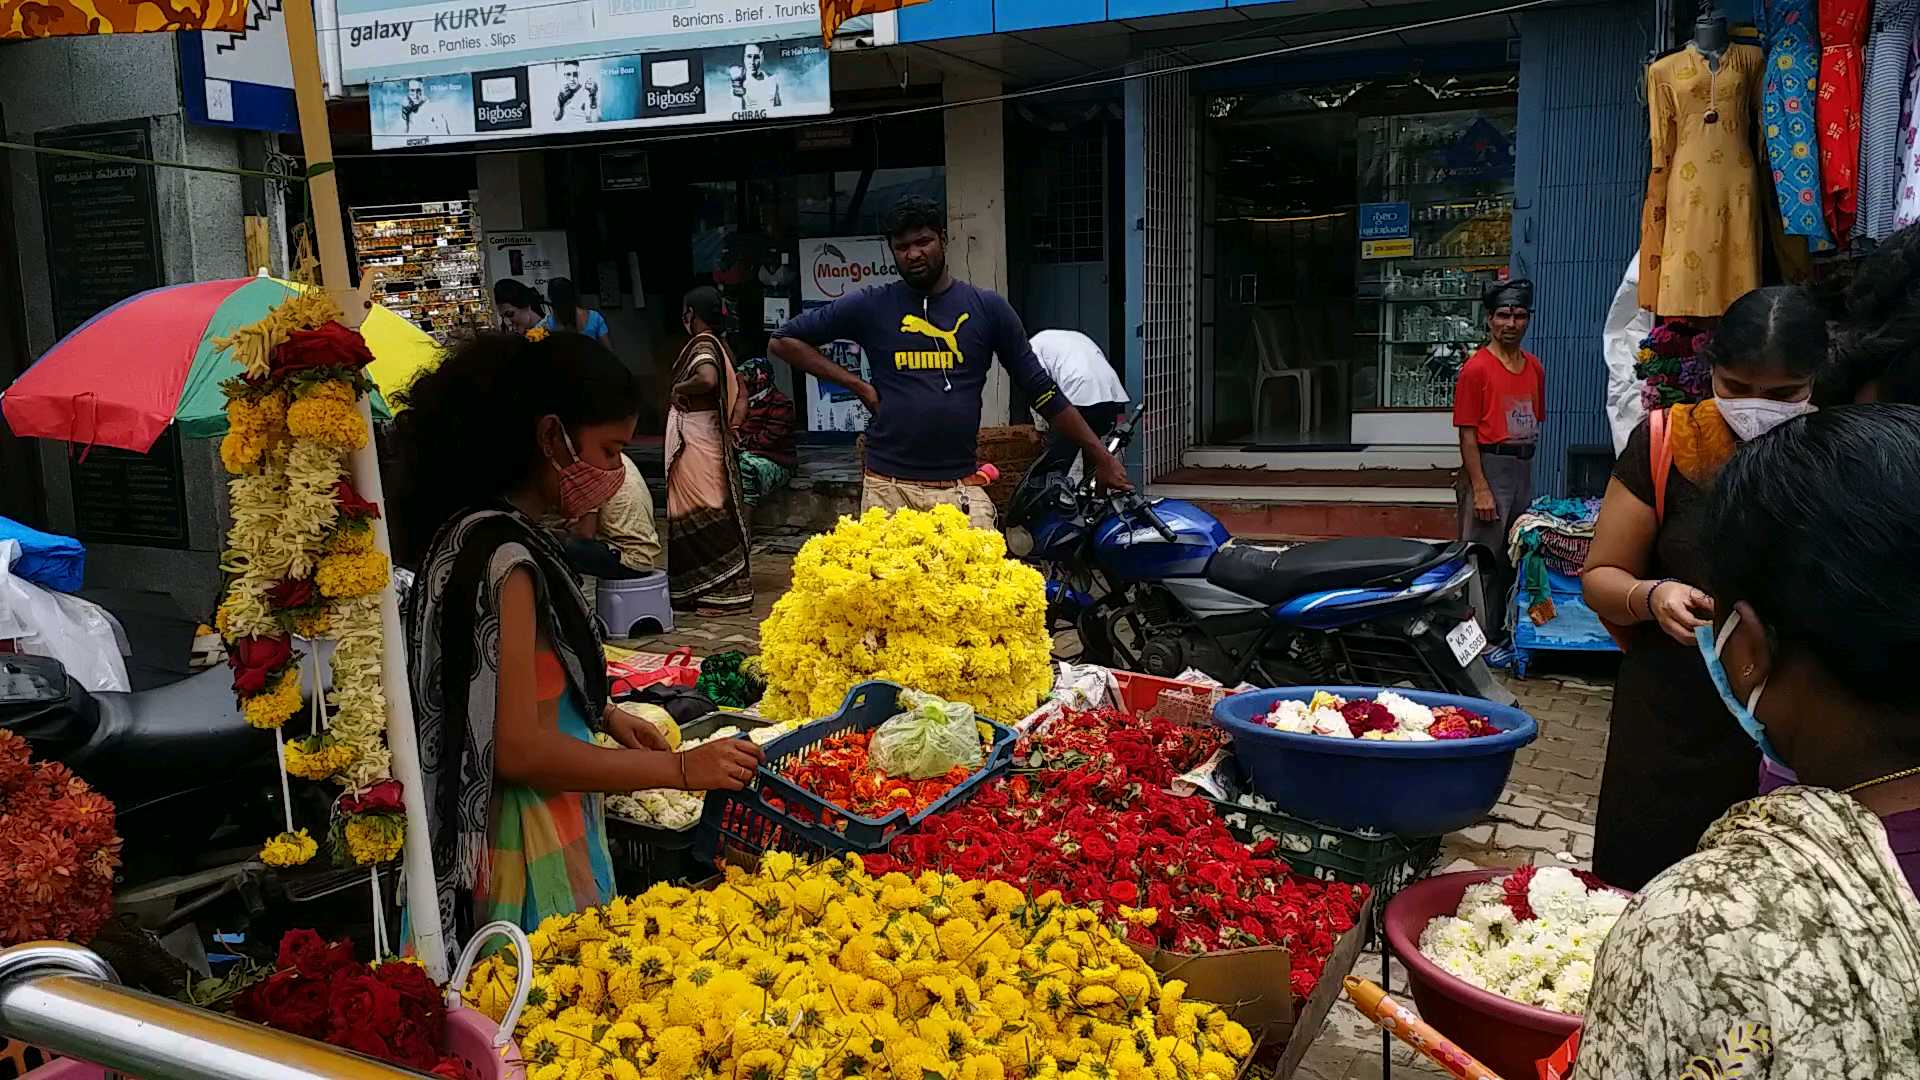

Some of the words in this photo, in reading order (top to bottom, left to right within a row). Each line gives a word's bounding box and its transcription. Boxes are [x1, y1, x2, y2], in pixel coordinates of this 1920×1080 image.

[350, 20, 414, 47] galaxy
[433, 4, 507, 33] KURVZ
[672, 12, 724, 28] Banians
[735, 6, 764, 22] Brief
[774, 1, 816, 18] Trunks
[410, 43, 429, 56] Bra
[438, 37, 481, 53] Panties
[490, 33, 516, 47] Slips
[647, 88, 696, 110] Bigboss
[477, 105, 523, 124] Bigboss
[817, 261, 898, 283] MangoLea
[894, 351, 954, 371] PUMA
[1455, 633, 1468, 648] KA
[1465, 624, 1474, 636] 17
[1458, 649, 1472, 664] HA
